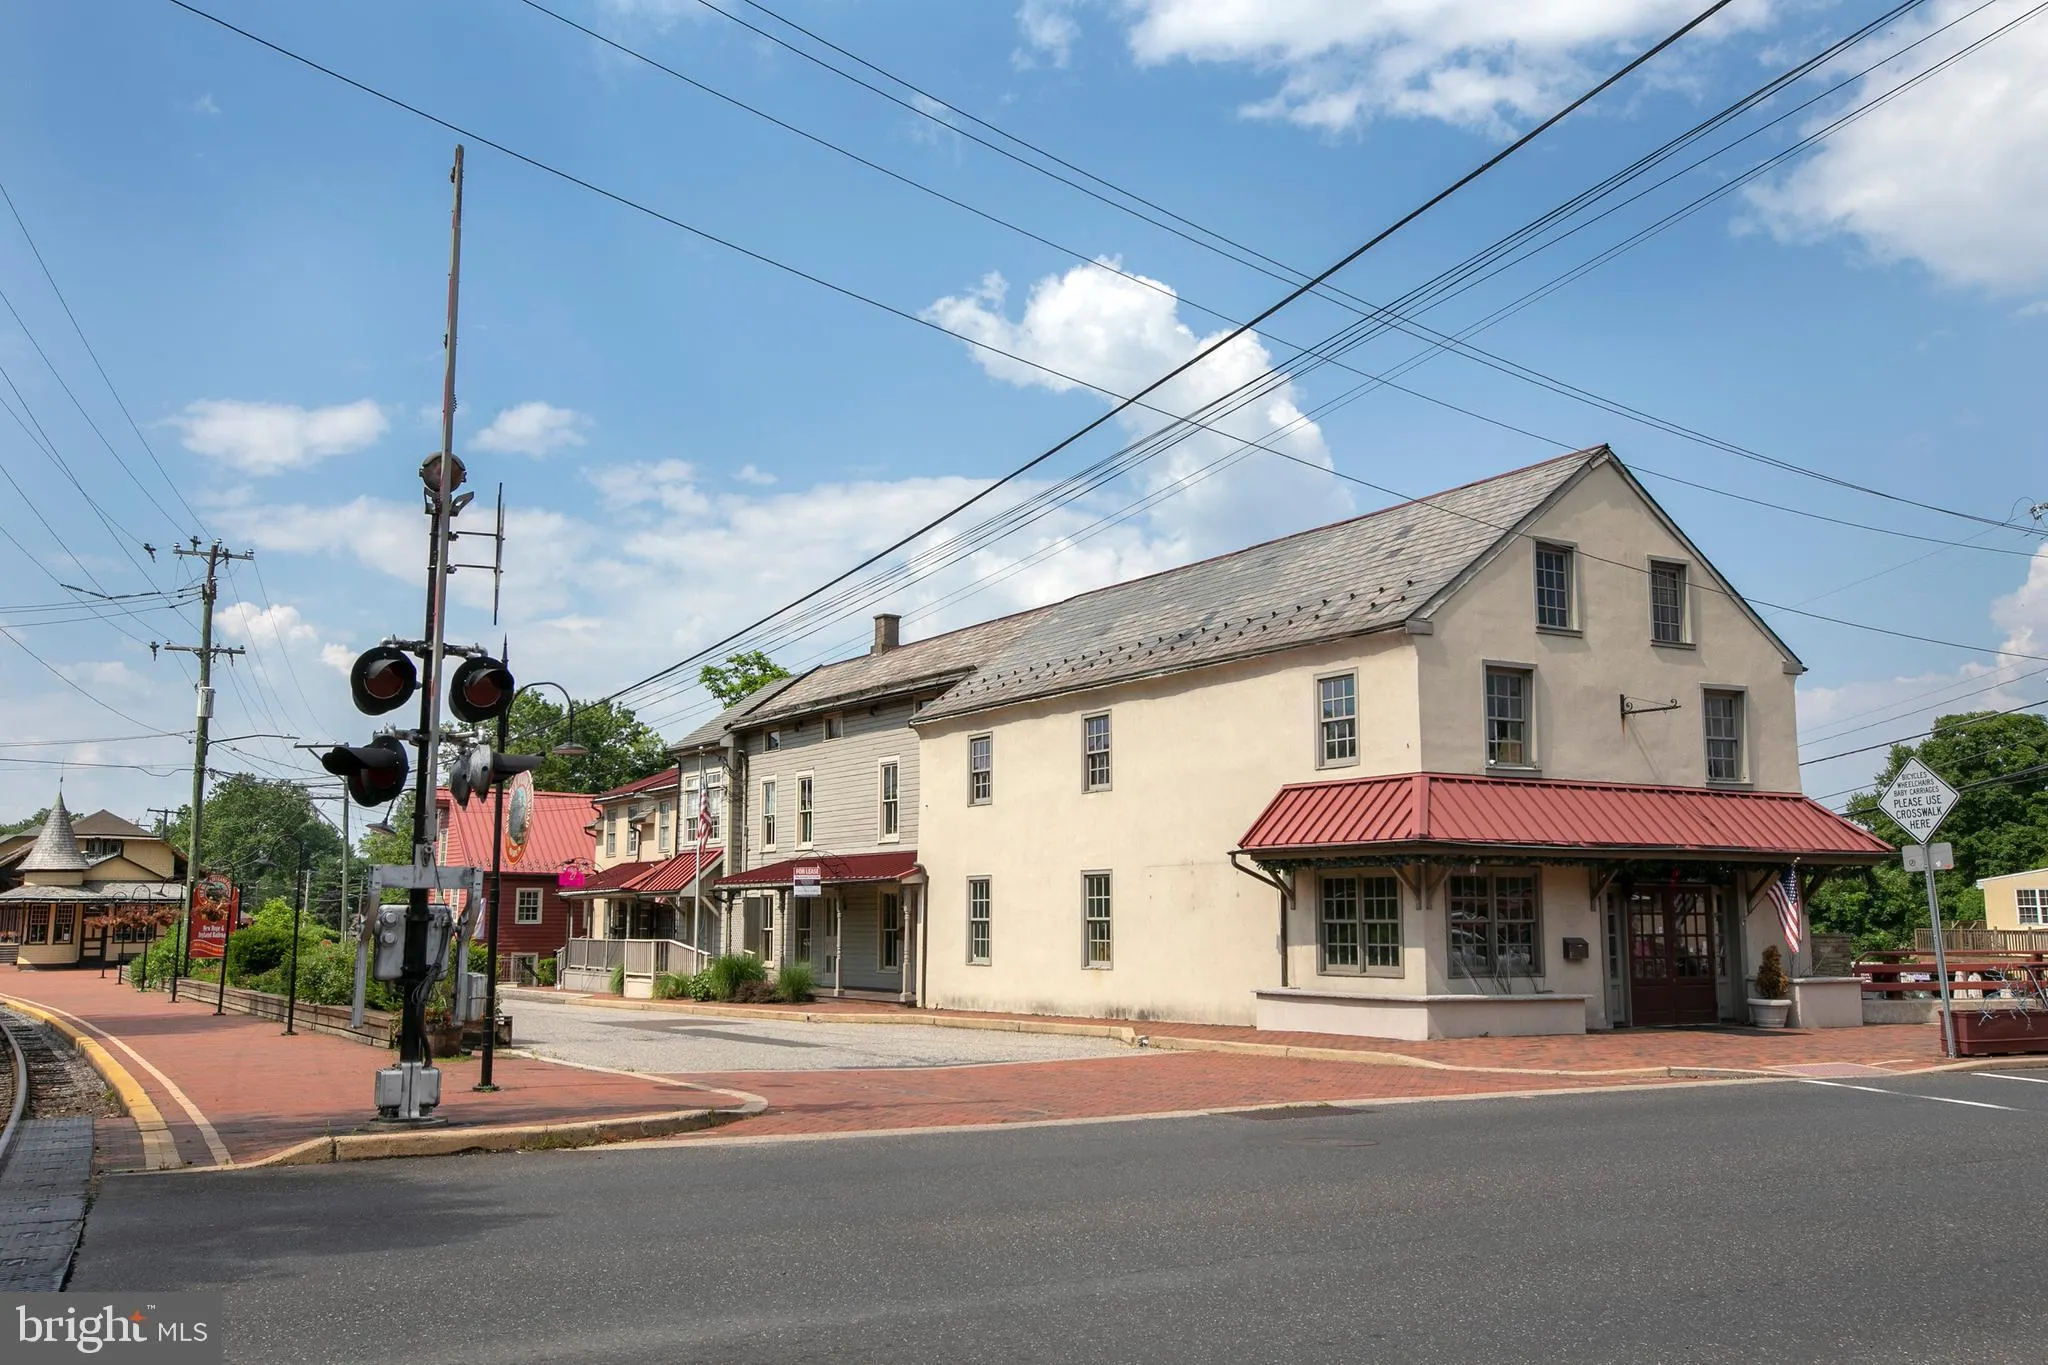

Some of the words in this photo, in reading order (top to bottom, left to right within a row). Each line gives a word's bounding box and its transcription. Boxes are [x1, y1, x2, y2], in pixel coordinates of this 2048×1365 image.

[1902, 772, 1927, 780] BICYCLES
[1897, 778, 1934, 788] WHEELCHAIRS
[1910, 786, 1939, 795] CARRIAGES
[1894, 797, 1923, 808] PLEASE
[1926, 795, 1942, 805] USE
[1896, 806, 1942, 819] CROSSWALK
[1910, 819, 1931, 829] HERE
